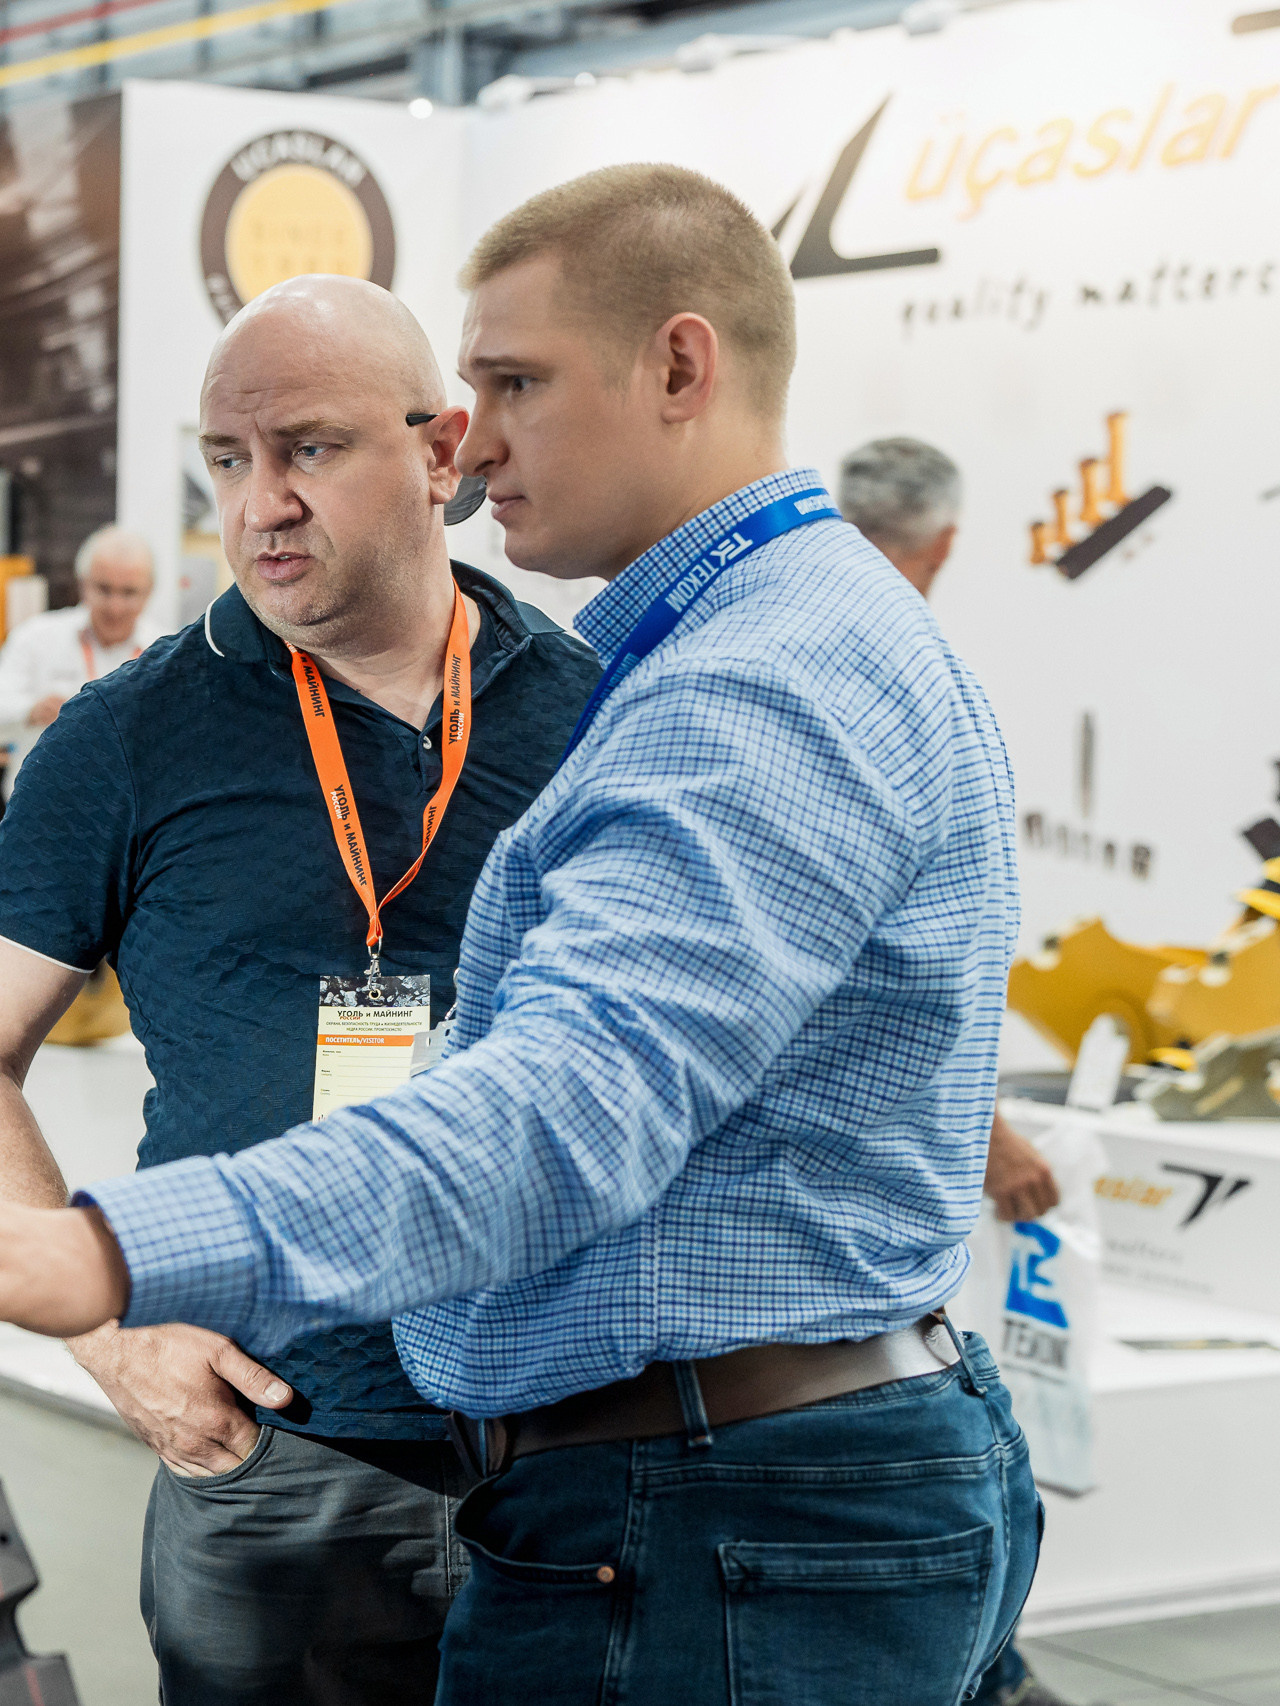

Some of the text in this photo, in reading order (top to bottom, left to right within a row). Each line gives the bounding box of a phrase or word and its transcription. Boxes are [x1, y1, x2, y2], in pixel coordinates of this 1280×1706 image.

[664, 558, 720, 614] TEKOM
[302, 665, 326, 718] МАЙНИНГ
[450, 653, 462, 699] МАЙНИНГ
[448, 708, 460, 745] УГОЛЬ
[456, 712, 465, 740] РОССИИ
[330, 791, 342, 820] РОССИИ
[334, 784, 351, 821] УГОЛЬ
[346, 832, 367, 887] МАЙНИНГ
[373, 1009, 413, 1017] МАЙНИНГ
